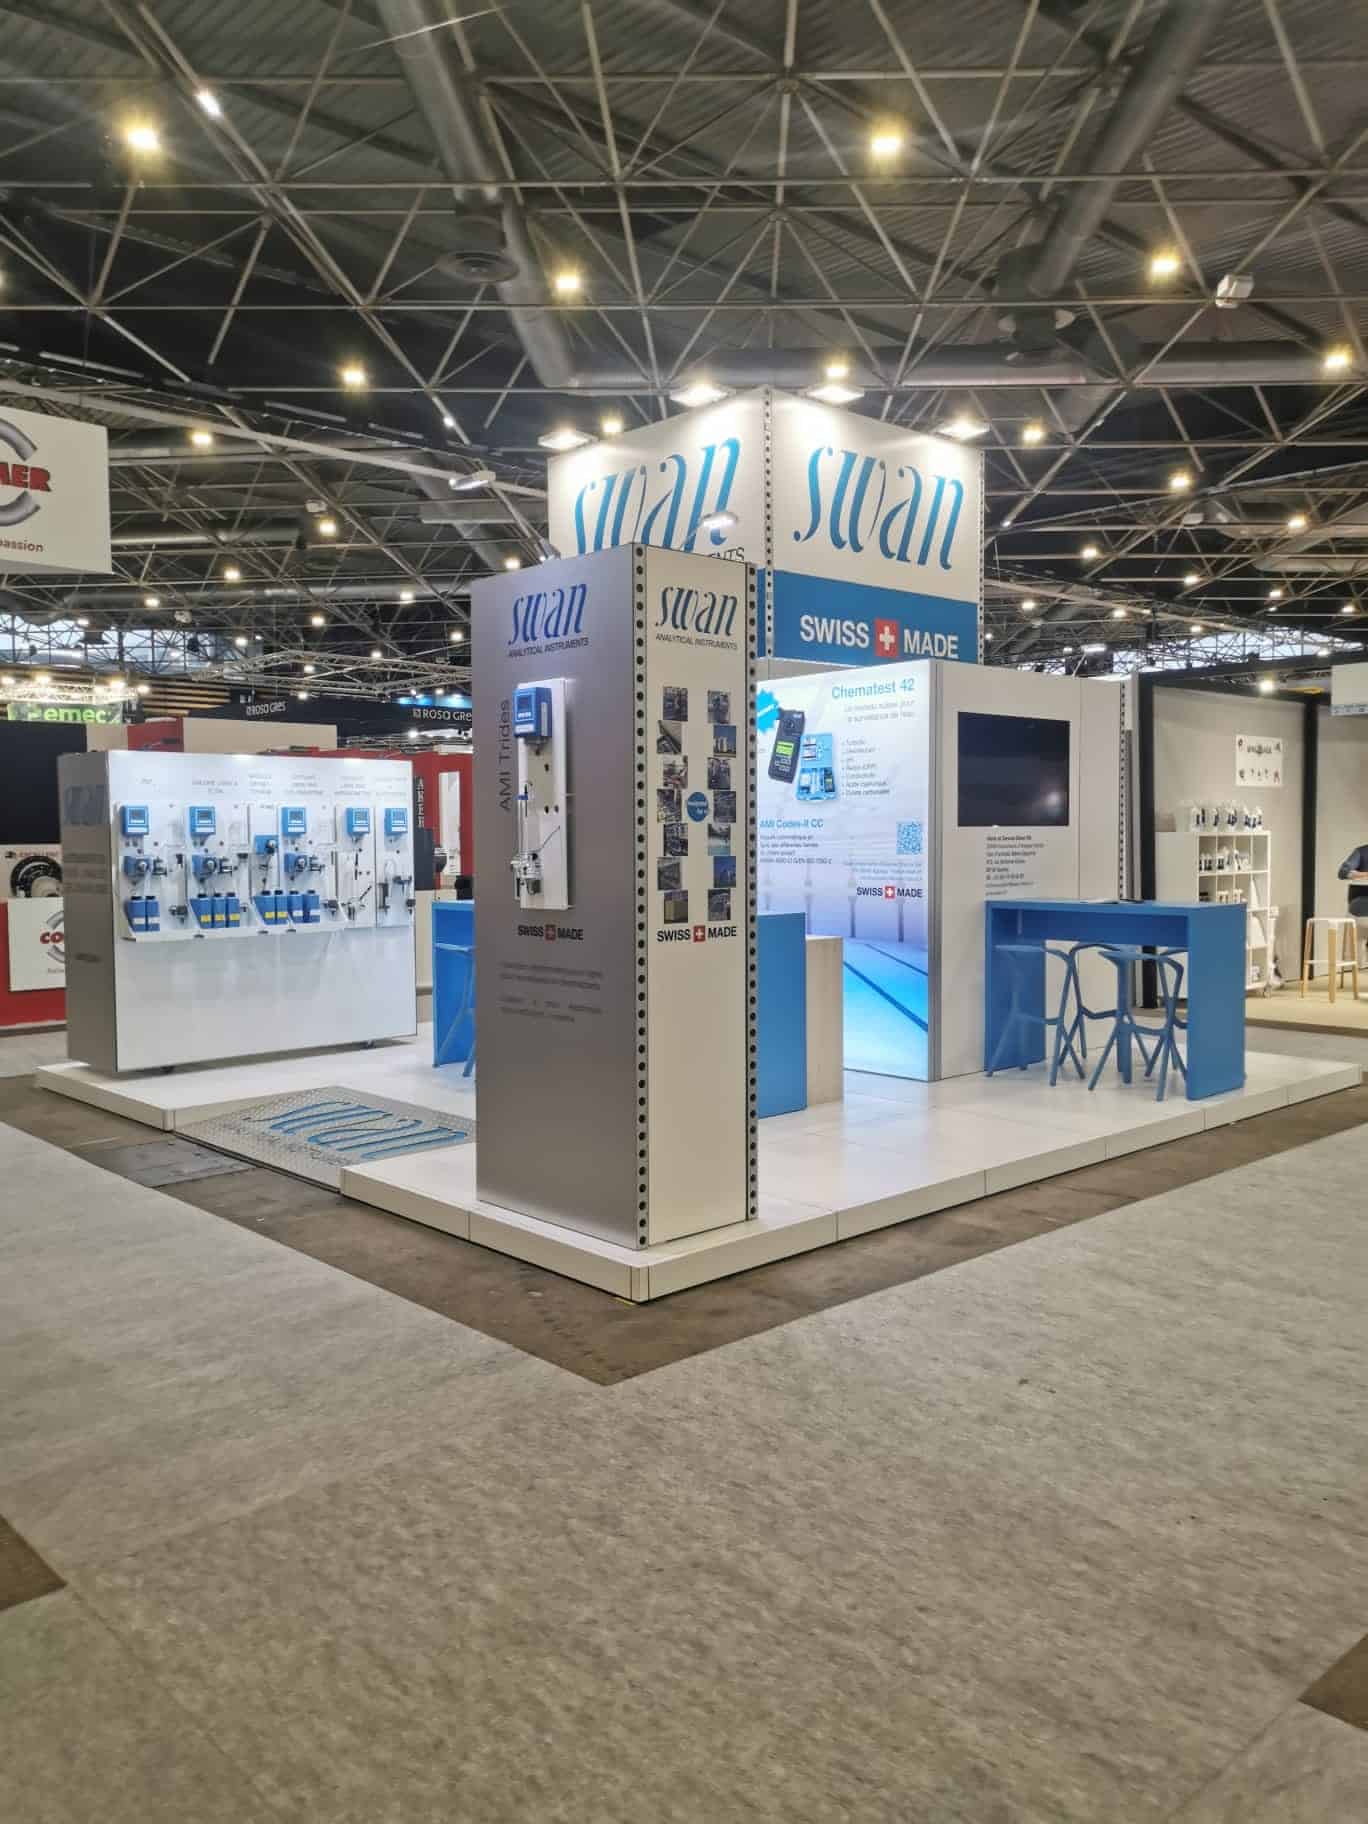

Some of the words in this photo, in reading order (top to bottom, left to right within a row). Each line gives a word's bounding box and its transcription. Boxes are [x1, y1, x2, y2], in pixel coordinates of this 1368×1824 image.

[574, 436, 741, 552] swan
[793, 445, 965, 571] swan
[507, 583, 588, 646] swan
[654, 586, 739, 637] swan
[800, 614, 871, 650] SWISS
[903, 627, 960, 660] MADE
[831, 679, 897, 700] Chematest
[899, 677, 915, 692] 42
[498, 699, 511, 764] Trides
[498, 771, 512, 812] AMI
[856, 886, 883, 897] SWISS
[896, 887, 923, 898] MADE
[517, 924, 544, 937] SWISS
[557, 927, 584, 941] MADE
[656, 928, 691, 942] SWISS
[707, 926, 737, 940] MADE
